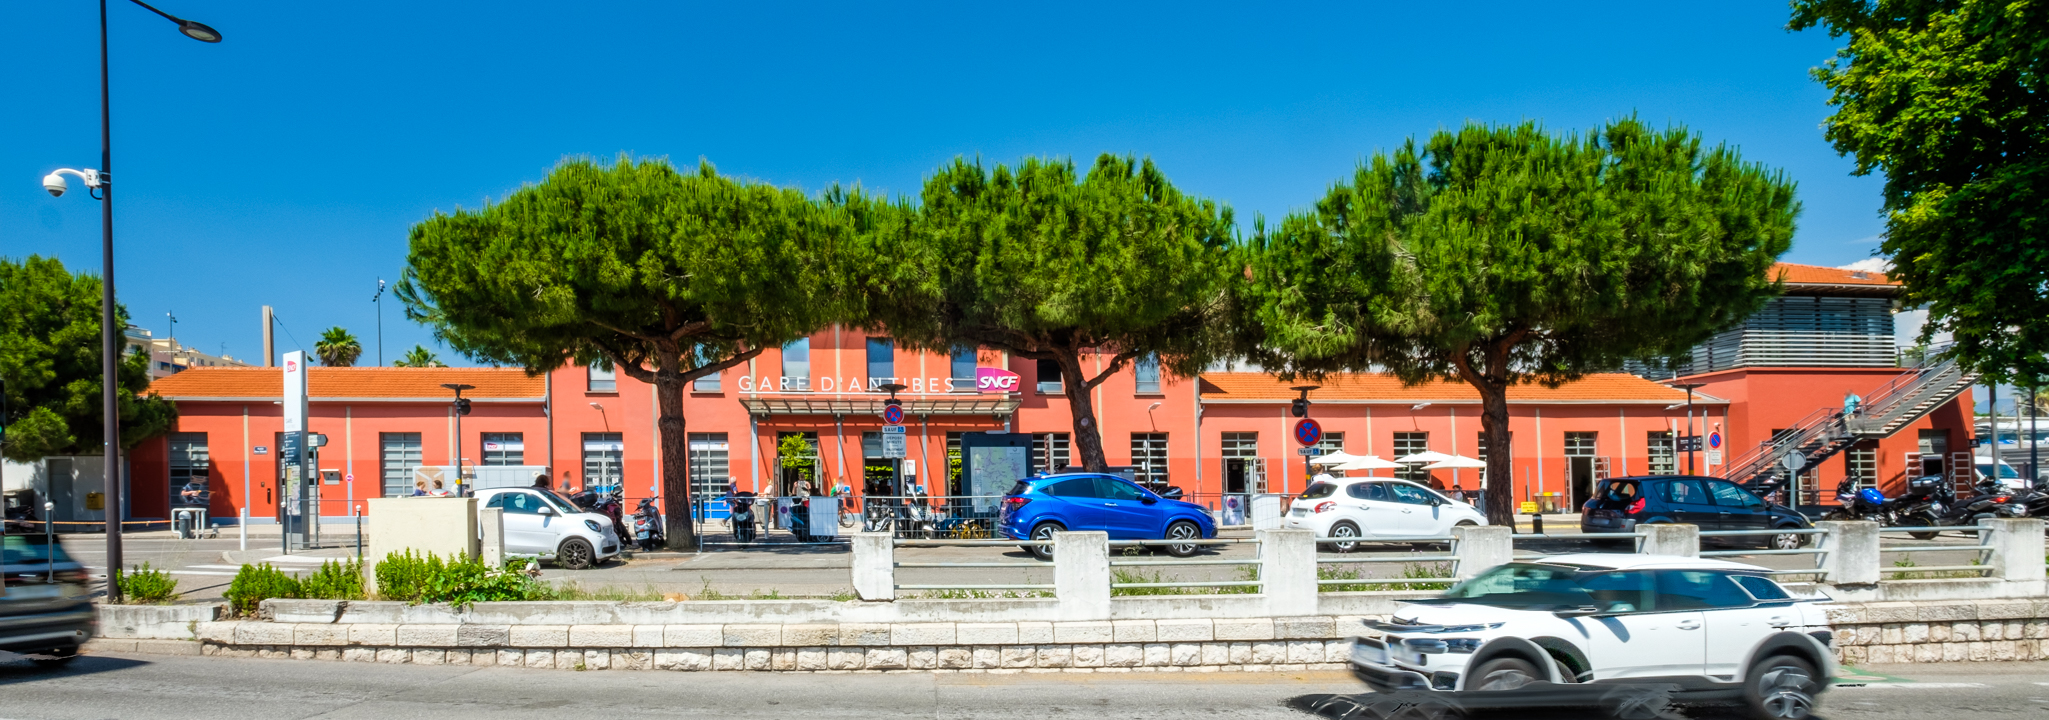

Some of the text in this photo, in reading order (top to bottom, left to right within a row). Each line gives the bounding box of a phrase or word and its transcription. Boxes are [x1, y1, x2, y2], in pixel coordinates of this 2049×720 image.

[738, 375, 955, 392] GARE D'ANTIBES
[978, 375, 1018, 389] SNCF
